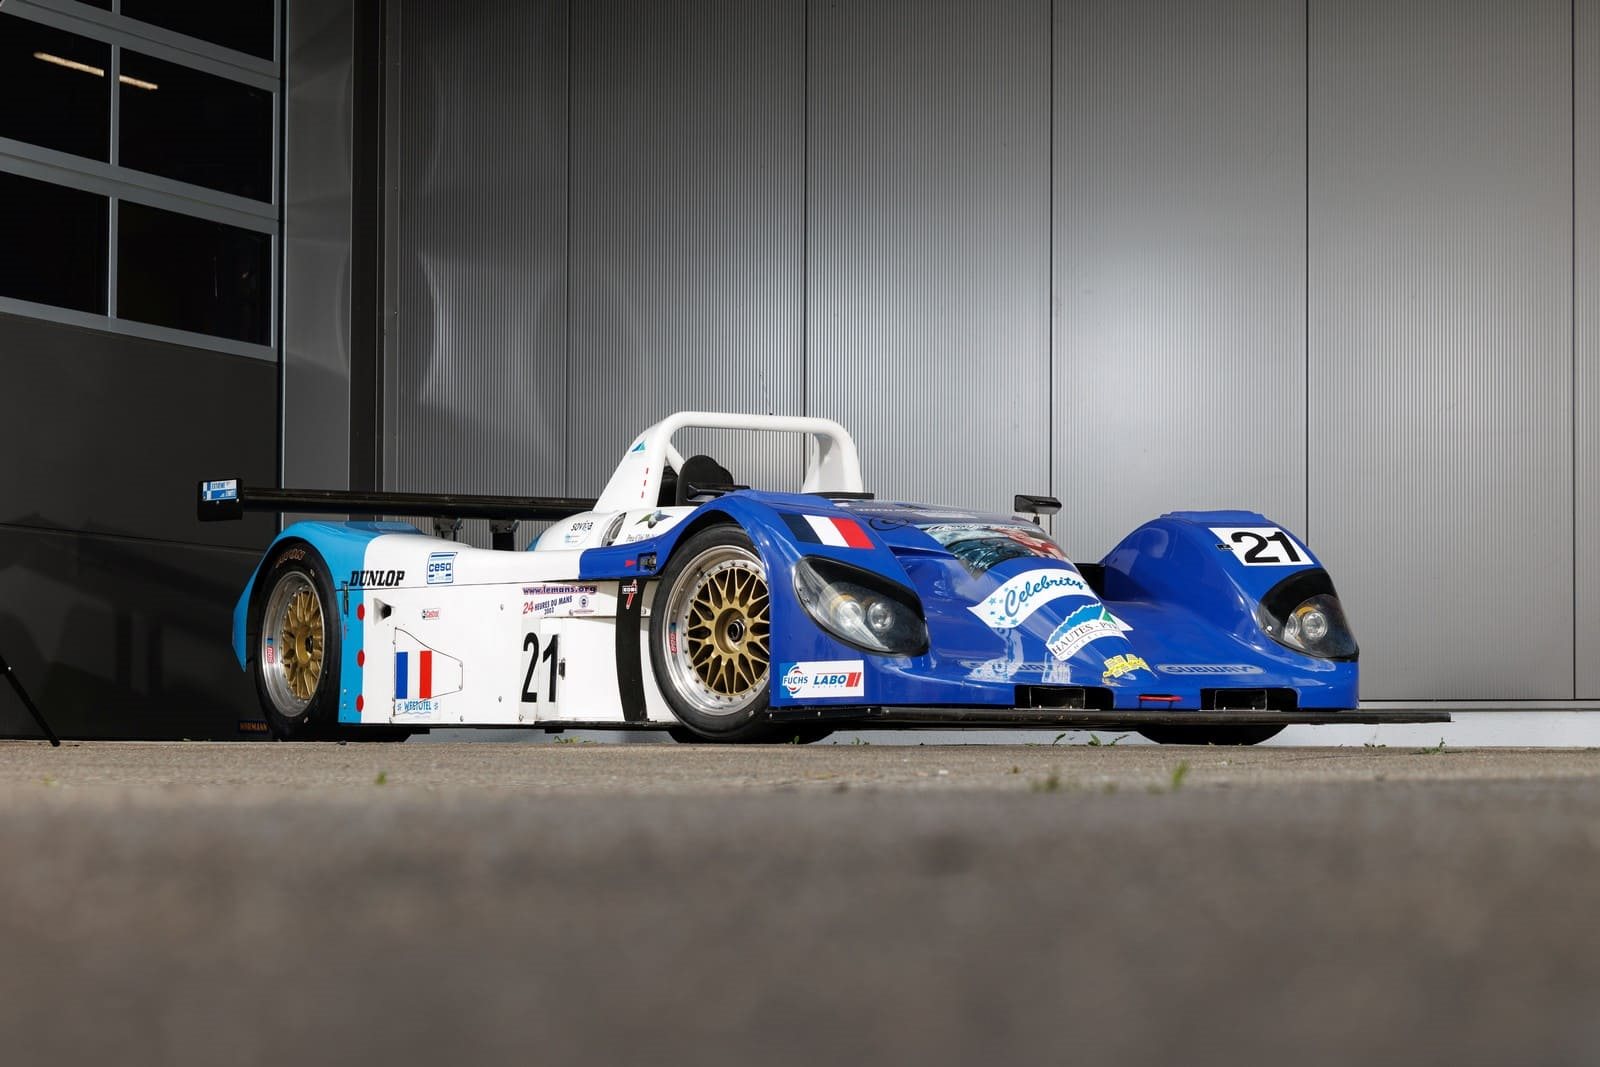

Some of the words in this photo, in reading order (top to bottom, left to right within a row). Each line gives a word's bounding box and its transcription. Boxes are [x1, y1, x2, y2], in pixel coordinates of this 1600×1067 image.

[1231, 531, 1301, 563] 21
[428, 562, 452, 573] cesa
[349, 570, 405, 587] DUNLOP
[522, 584, 597, 596] www.lemans.org
[1004, 574, 1086, 618] Celebrity
[523, 601, 534, 614] 24
[535, 600, 550, 611] HEURES
[551, 598, 557, 607] DU
[558, 595, 573, 606] MANS
[1051, 623, 1094, 655] HAUTES
[521, 632, 558, 703] 21
[1166, 665, 1255, 673] SUBWAY
[783, 676, 808, 685] FUCHS
[813, 675, 847, 685] LABO
